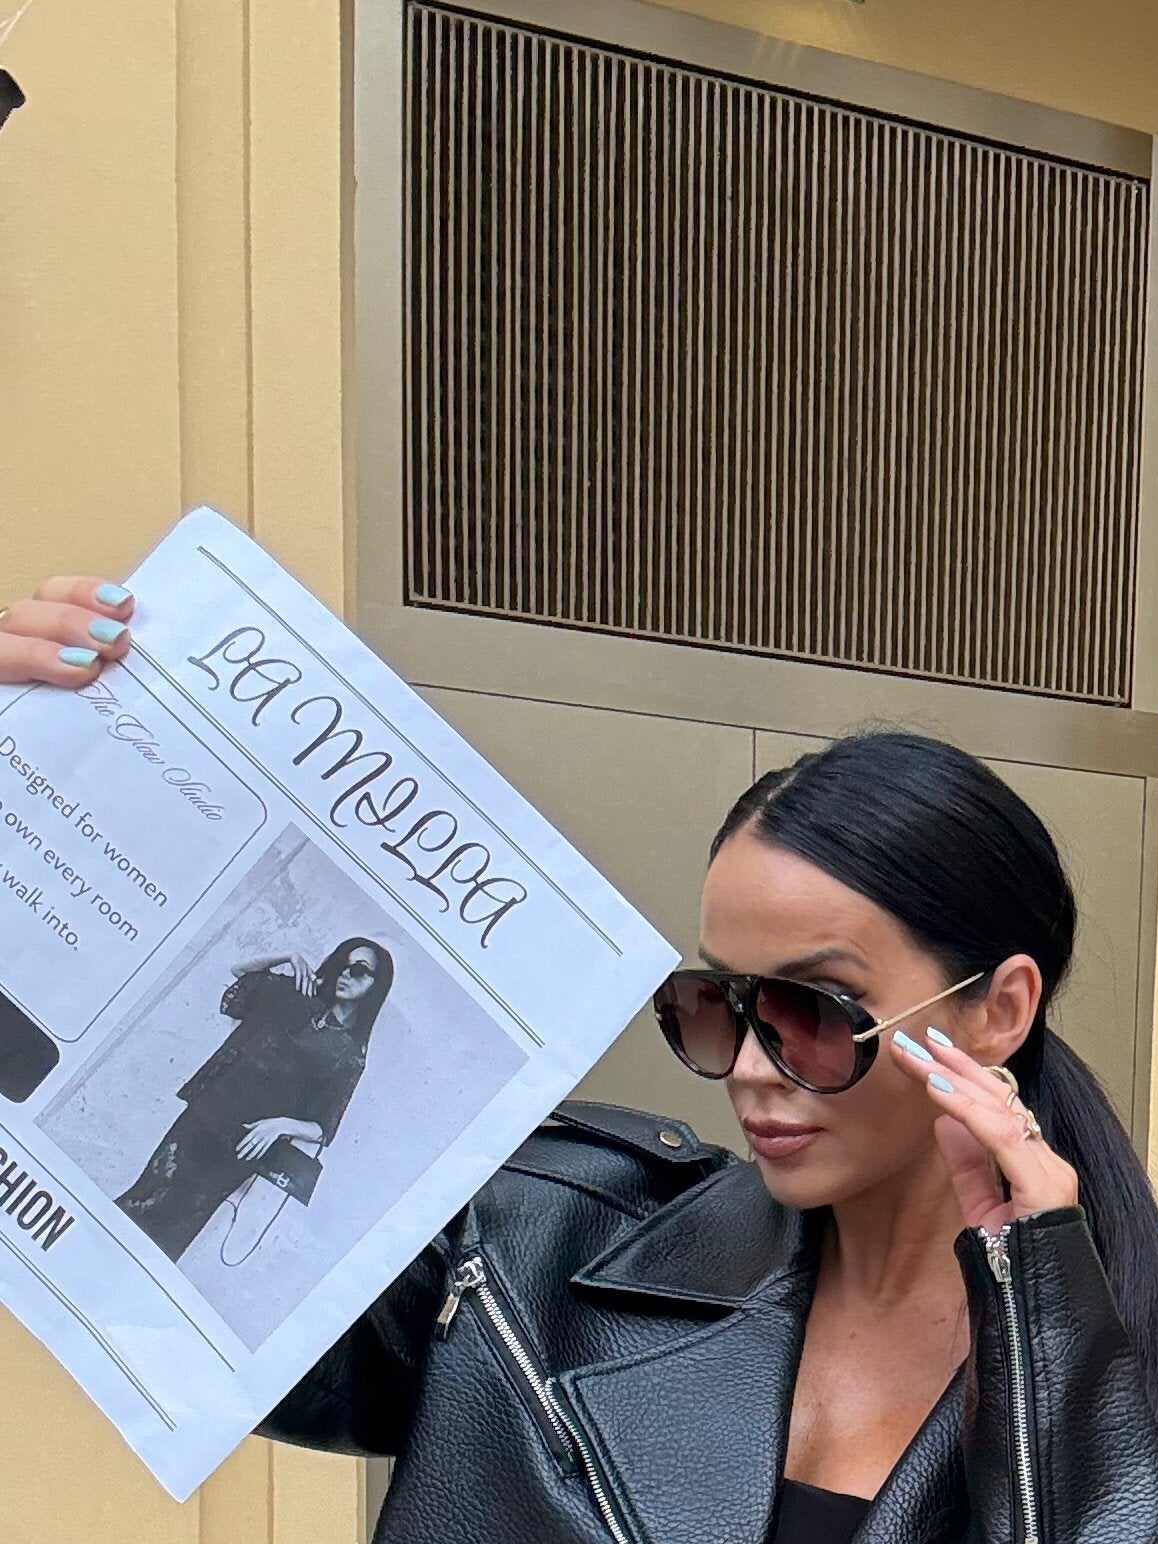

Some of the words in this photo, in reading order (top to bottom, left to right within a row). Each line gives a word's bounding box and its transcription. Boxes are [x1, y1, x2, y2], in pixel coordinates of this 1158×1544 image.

[187, 626, 302, 727] LA
[0, 735, 80, 820] Designed
[74, 811, 103, 844] for
[103, 841, 168, 908] women
[162, 767, 225, 821] Studio
[2, 869, 44, 914] walk
[41, 906, 80, 952] into.
[4, 811, 43, 852] own
[43, 848, 93, 898] every
[90, 892, 139, 942] room
